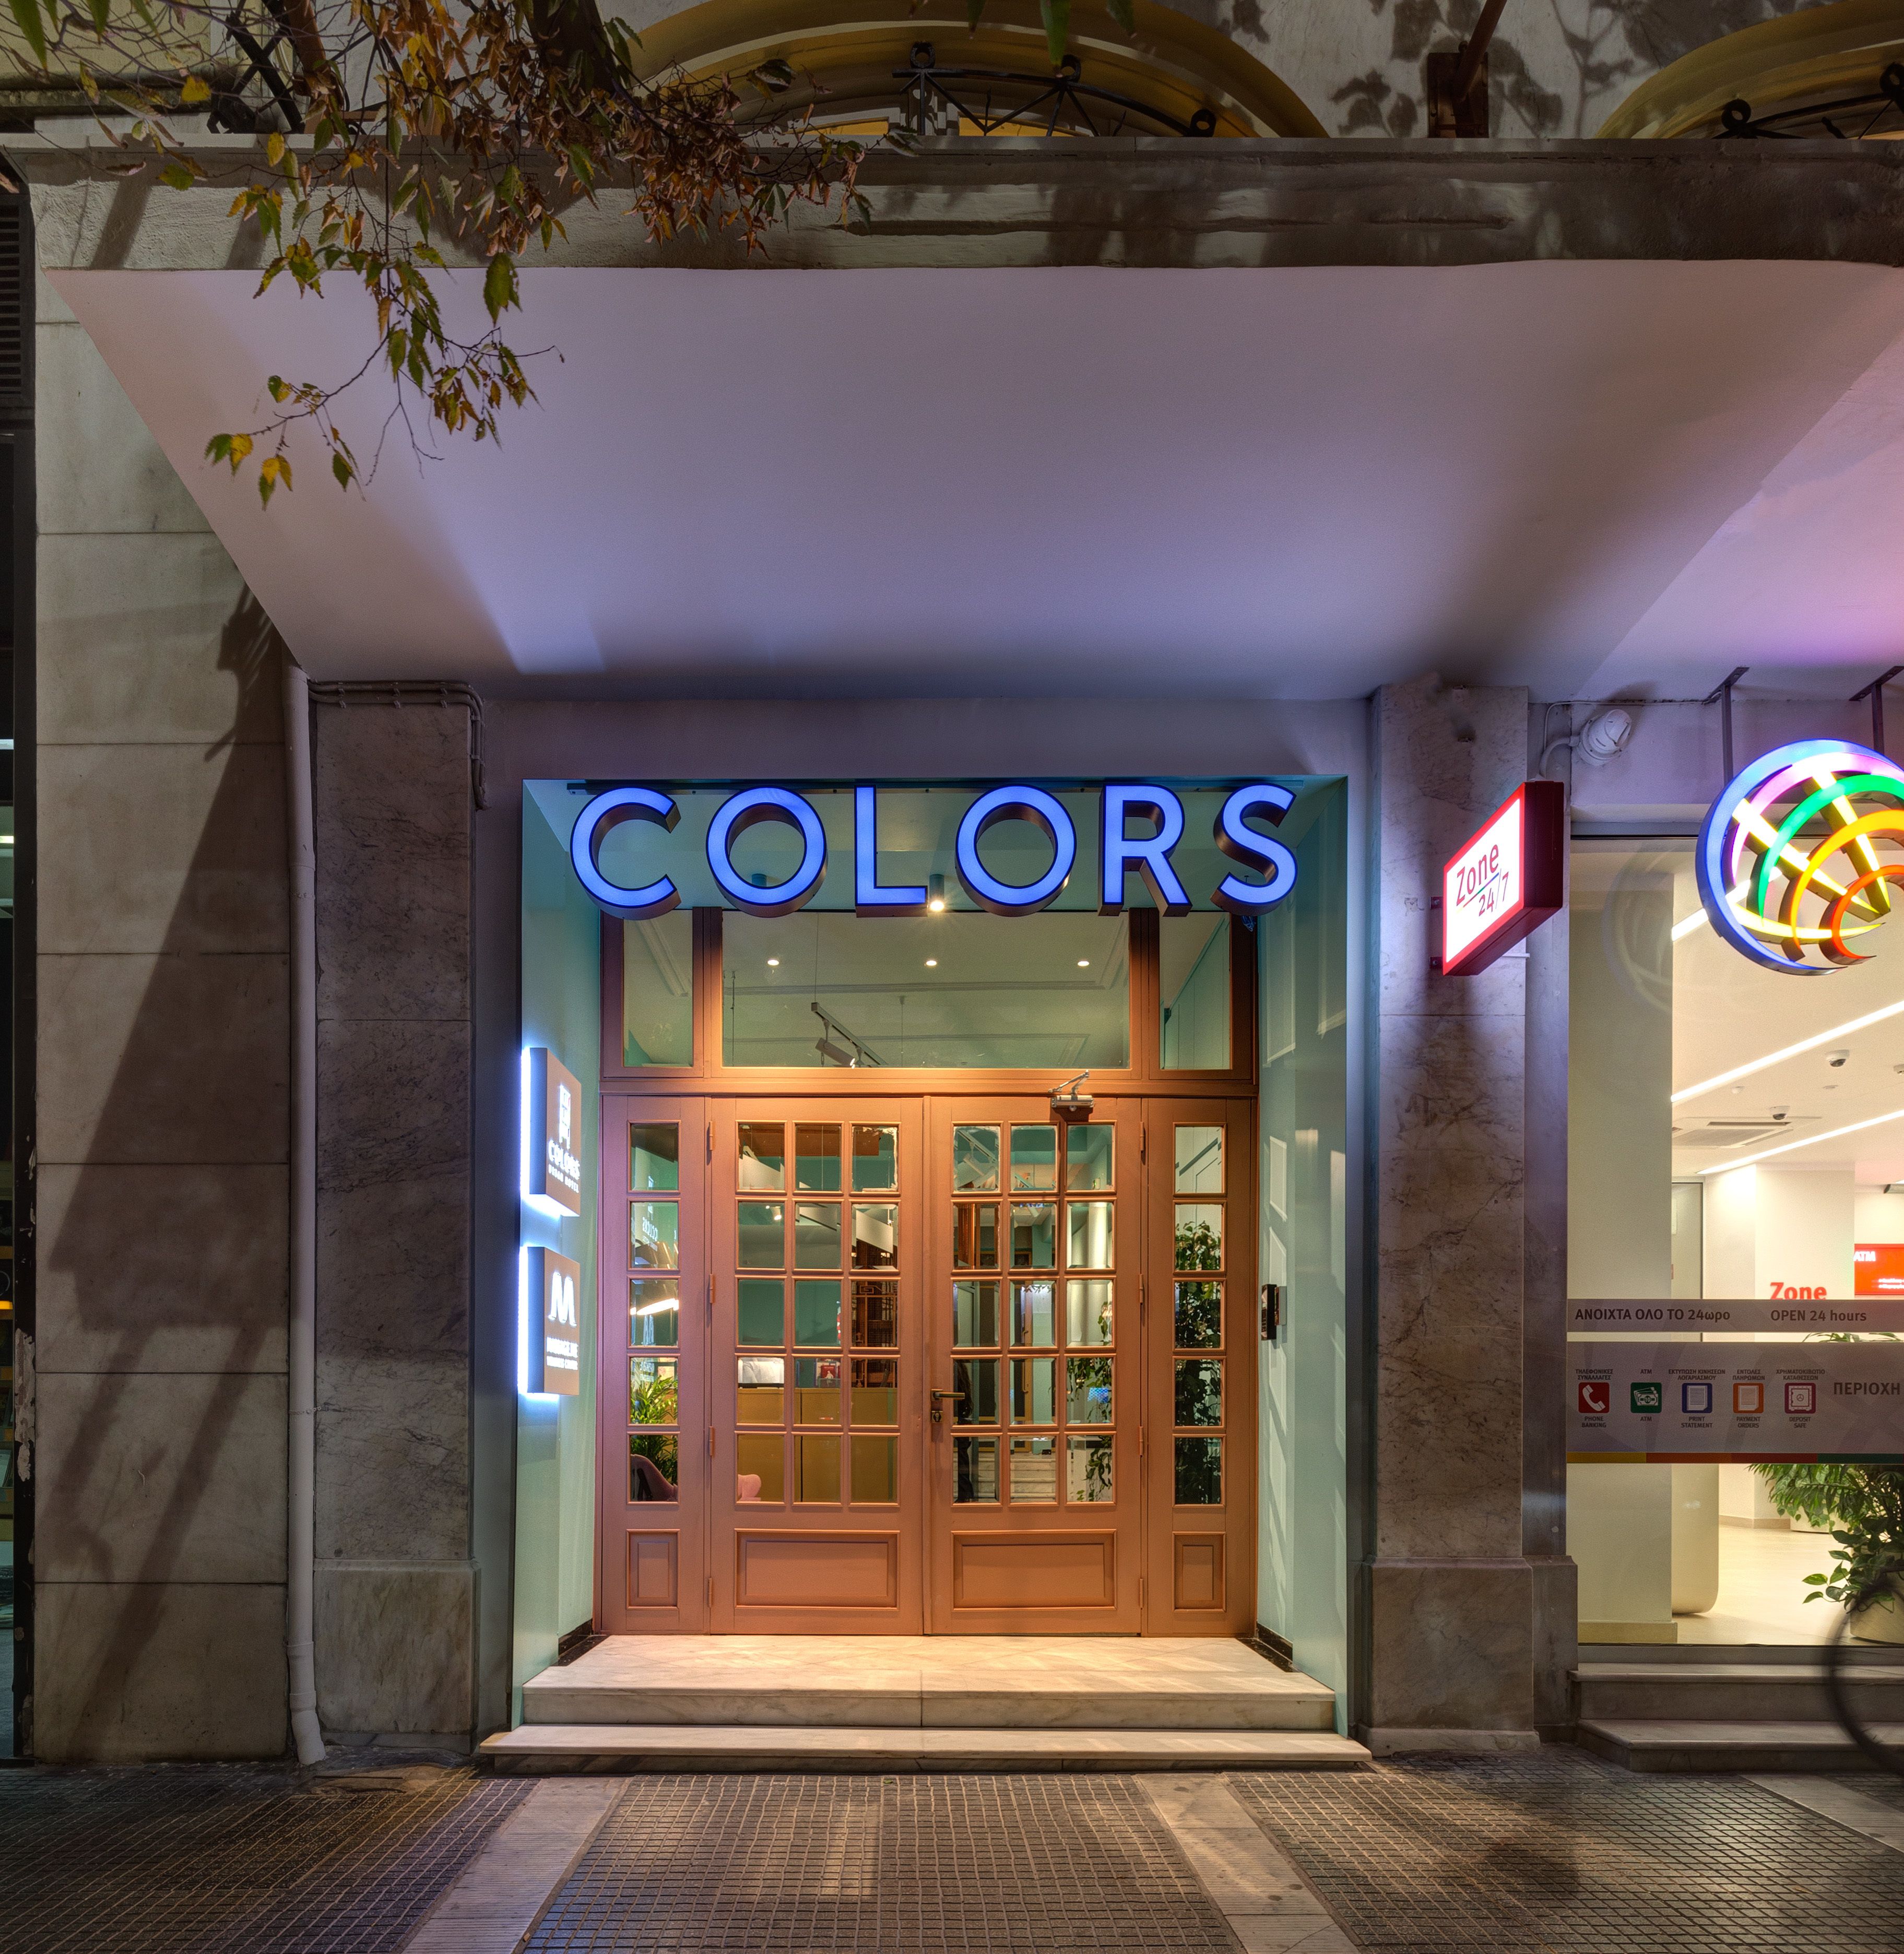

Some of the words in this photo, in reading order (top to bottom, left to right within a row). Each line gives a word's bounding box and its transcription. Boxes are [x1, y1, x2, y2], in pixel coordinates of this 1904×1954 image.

[570, 784, 1298, 914] COLORS
[1456, 844, 1499, 907] Zone
[1478, 868, 1509, 917] 24/7
[548, 1139, 580, 1180] COLORS
[1853, 1250, 1876, 1262] ATM
[548, 1271, 577, 1327] M
[1770, 1282, 1827, 1300] Zone
[1575, 1308, 1631, 1321] ΑΝΟΙΧΤΑ
[1635, 1309, 1663, 1321] ΟΛΟ
[1667, 1309, 1684, 1321] ΤΟ
[1687, 1309, 1731, 1322] 24ωρο
[1770, 1309, 1806, 1322] OPEN
[1809, 1309, 1826, 1322] 24
[1830, 1309, 1867, 1322] hours
[1833, 1382, 1900, 1395] ΠΕΡΙΟΧΗ
